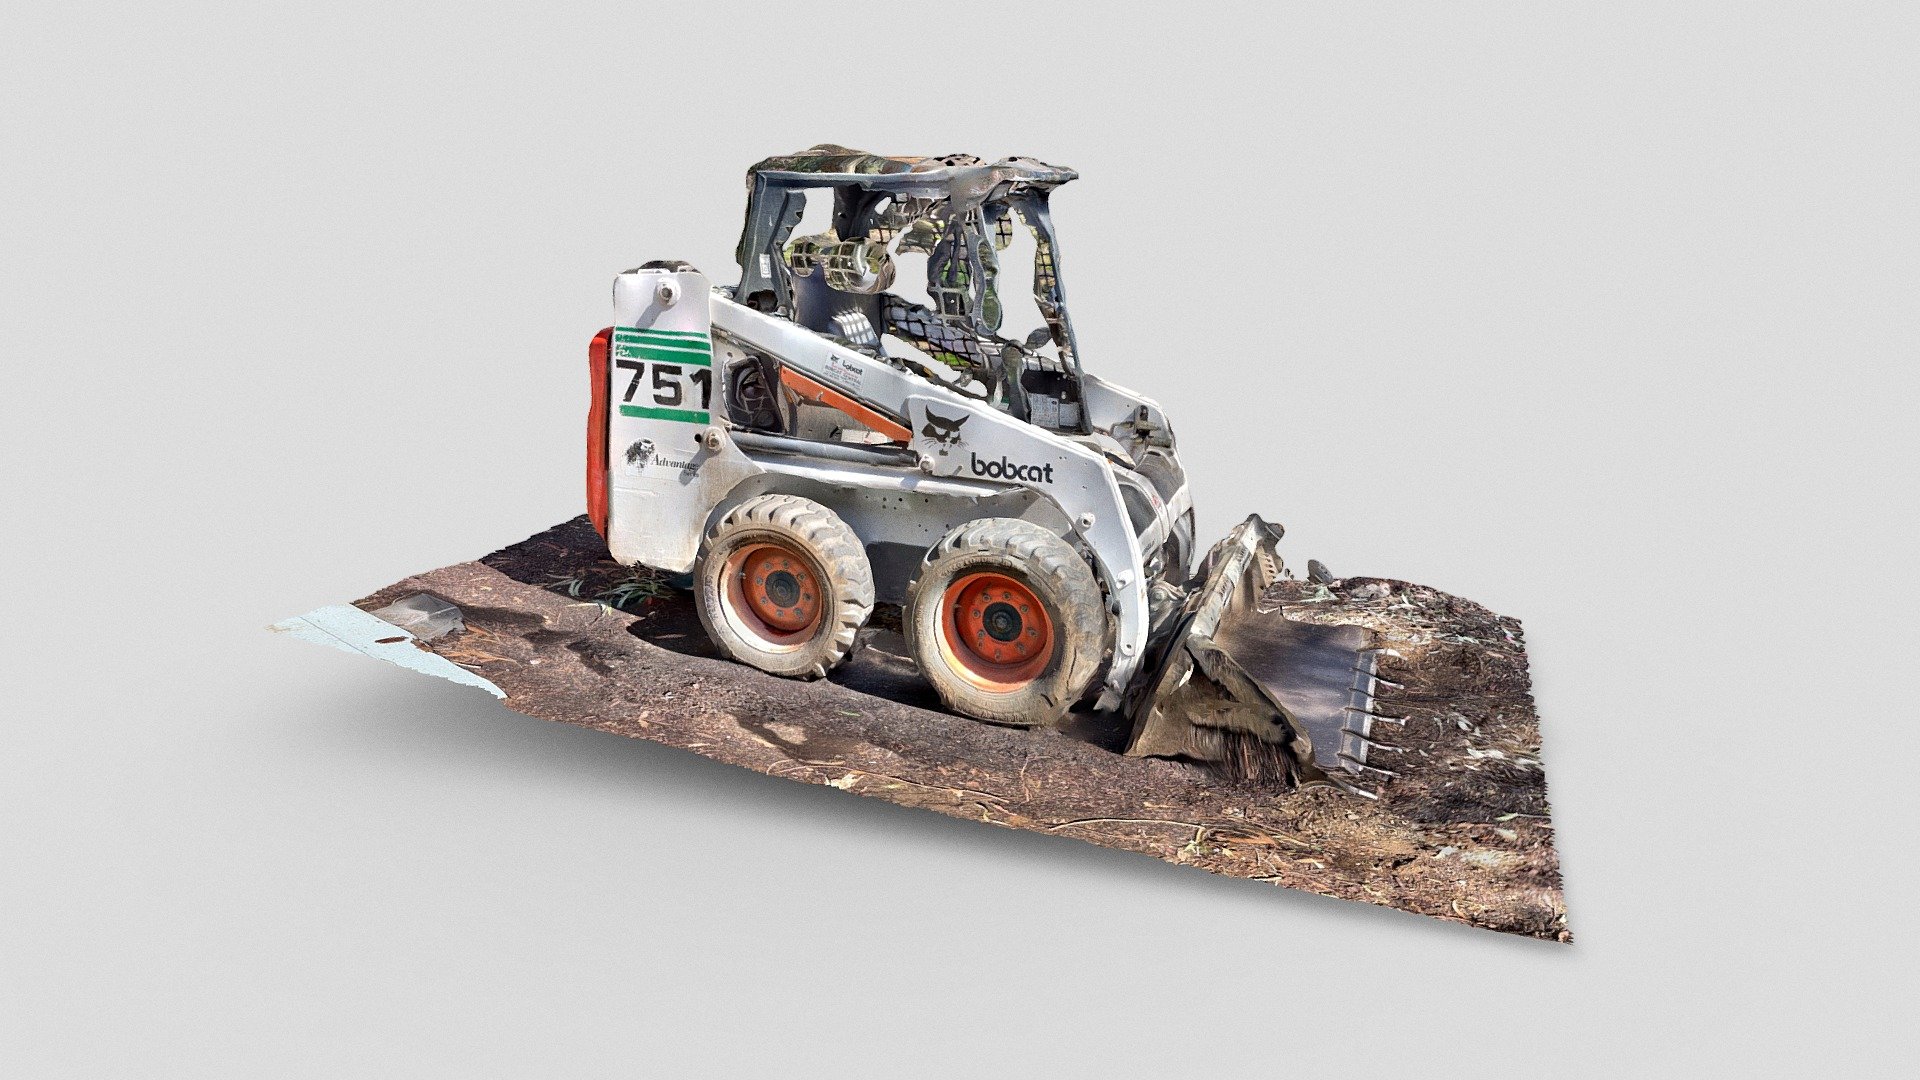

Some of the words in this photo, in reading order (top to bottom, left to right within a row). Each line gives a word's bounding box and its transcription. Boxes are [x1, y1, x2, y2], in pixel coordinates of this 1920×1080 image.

[842, 360, 862, 375] bobcat
[616, 359, 712, 409] 751
[651, 453, 700, 471] Advantage
[971, 452, 1053, 485] bobcat
